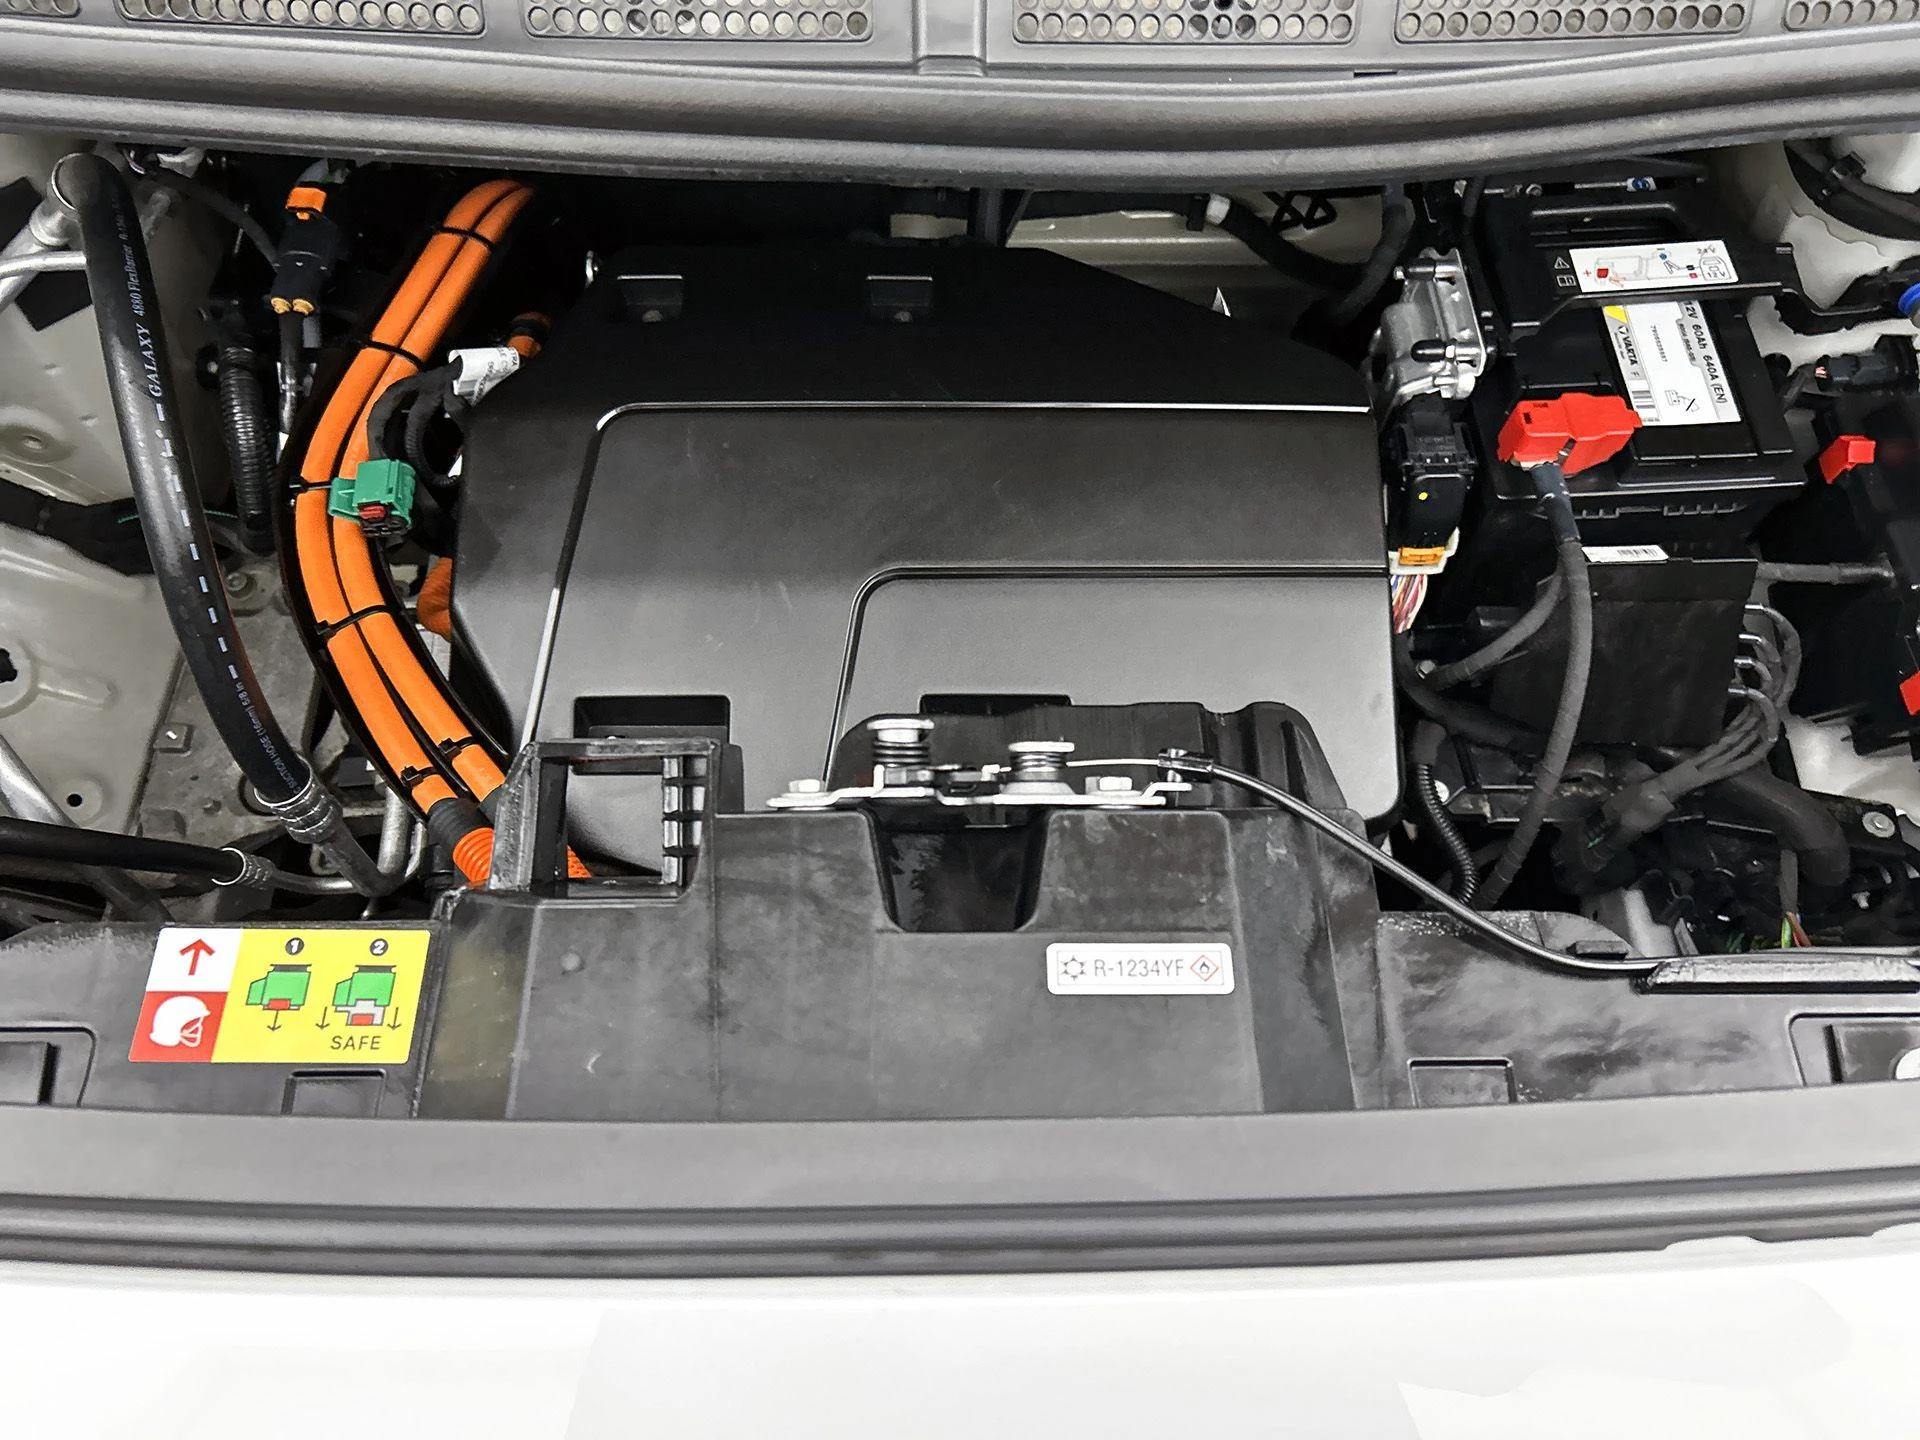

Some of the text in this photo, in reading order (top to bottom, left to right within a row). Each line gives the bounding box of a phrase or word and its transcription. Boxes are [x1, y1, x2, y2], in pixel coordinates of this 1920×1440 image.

[1684, 301, 1698, 319] 12V
[1692, 324, 1708, 350] 60Ah
[136, 322, 162, 397] GALAXY
[1622, 335, 1638, 366] VARTA
[1702, 354, 1719, 381] 640A
[1710, 383, 1728, 404] (EN)
[245, 705, 268, 736] (16mm)
[259, 734, 279, 760] HOSE
[273, 756, 299, 789] SUCTION
[1093, 958, 1185, 977] R-1234YF
[330, 1035, 383, 1051] SAFE
